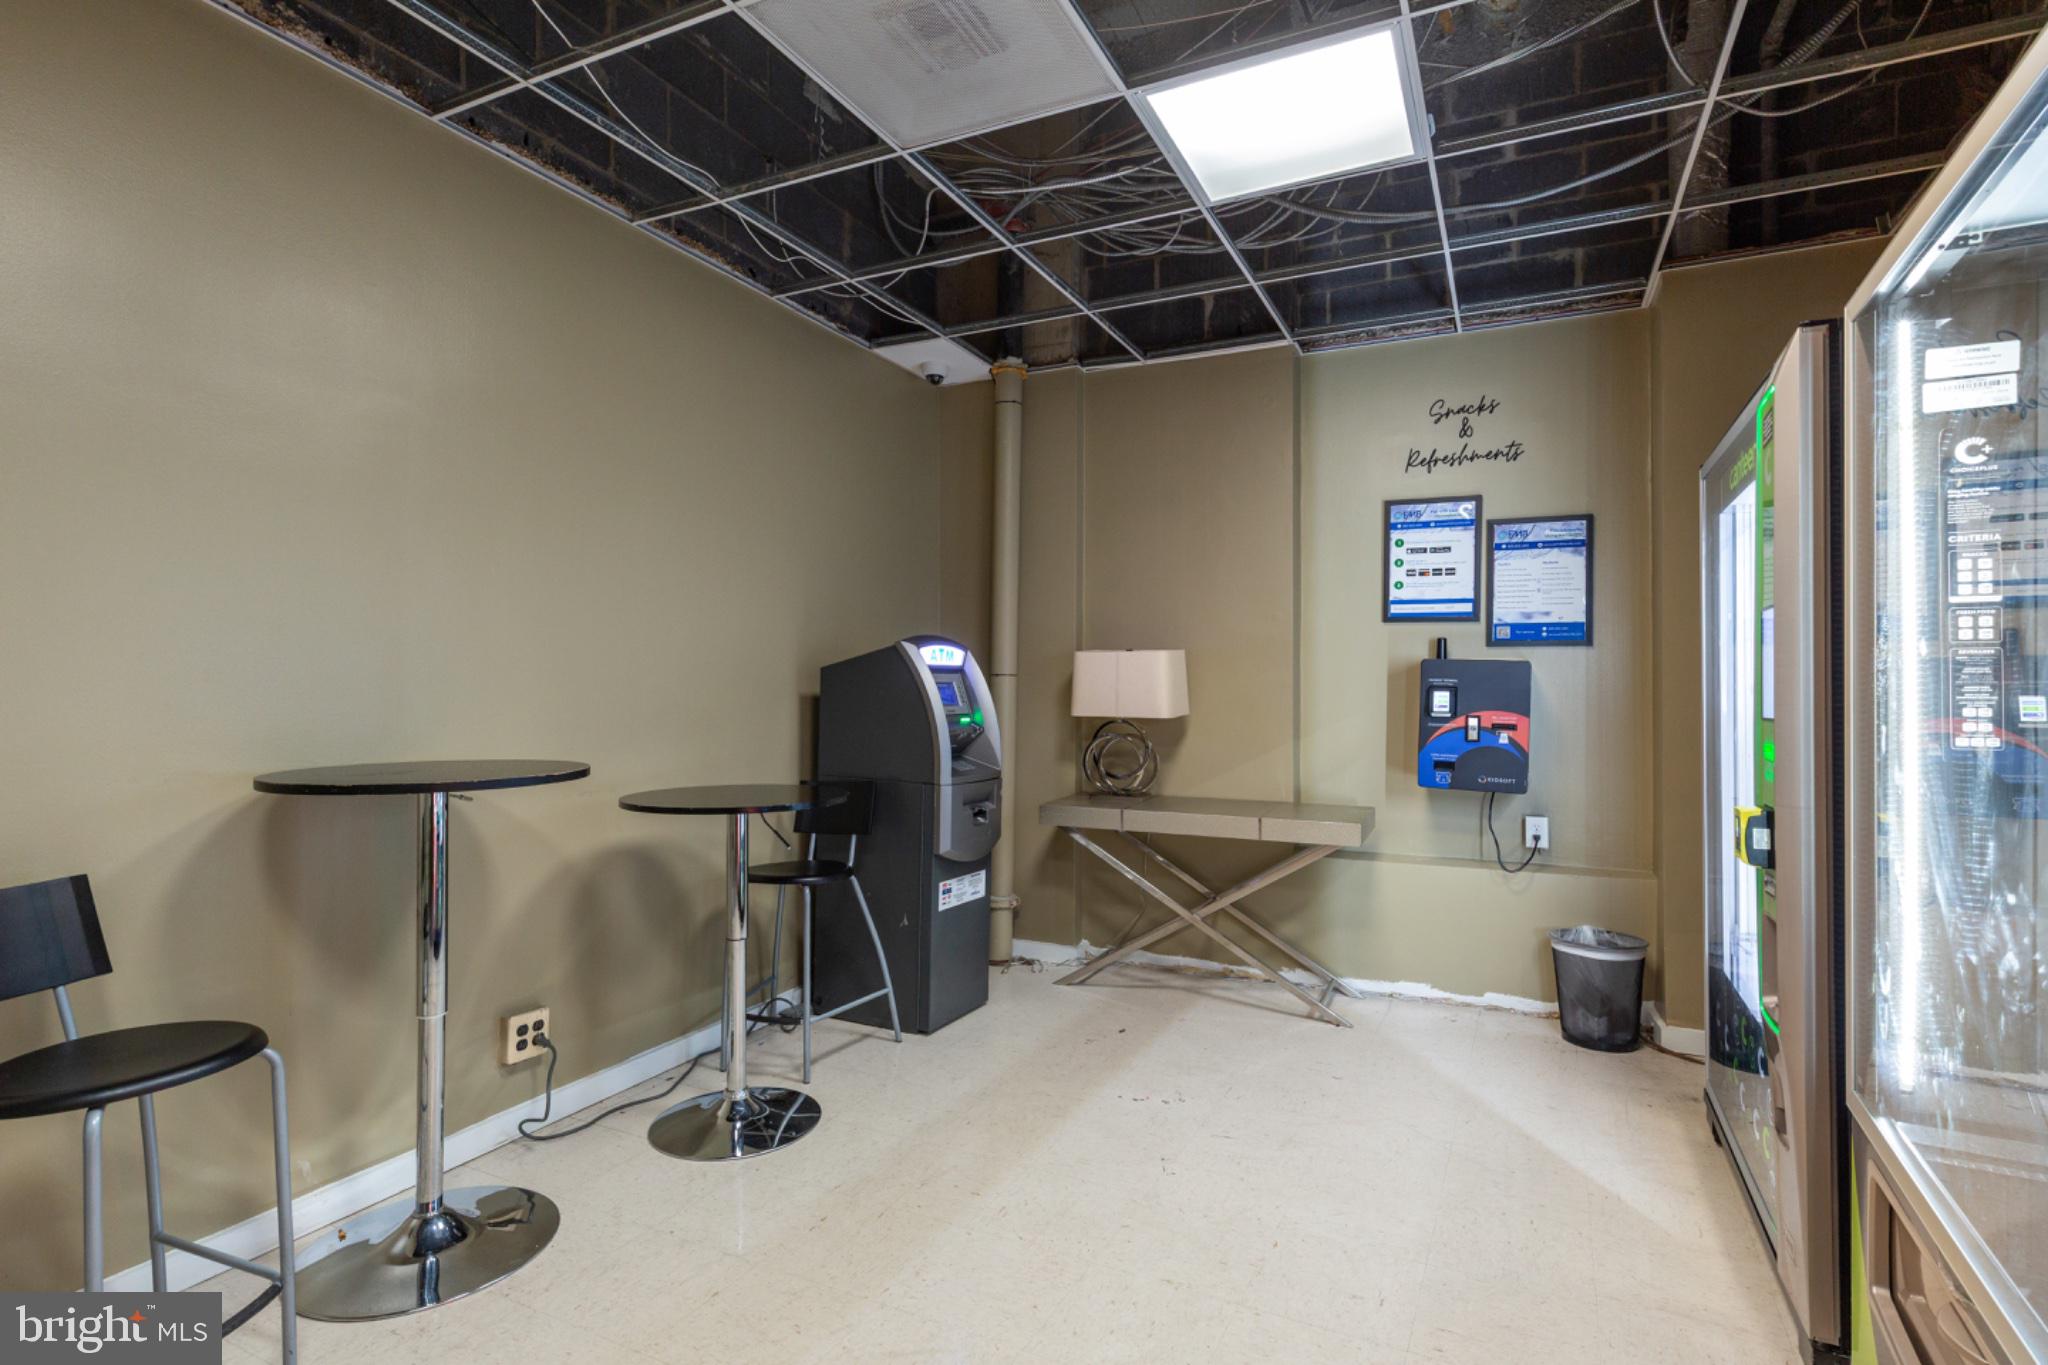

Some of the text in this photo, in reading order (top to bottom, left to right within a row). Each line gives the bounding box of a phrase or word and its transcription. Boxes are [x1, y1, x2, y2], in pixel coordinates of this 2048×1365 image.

[1429, 395, 1500, 424] Snacks
[1458, 417, 1474, 438] &
[1405, 440, 1525, 474] Refreshments
[1948, 533, 2001, 544] CRITERIA
